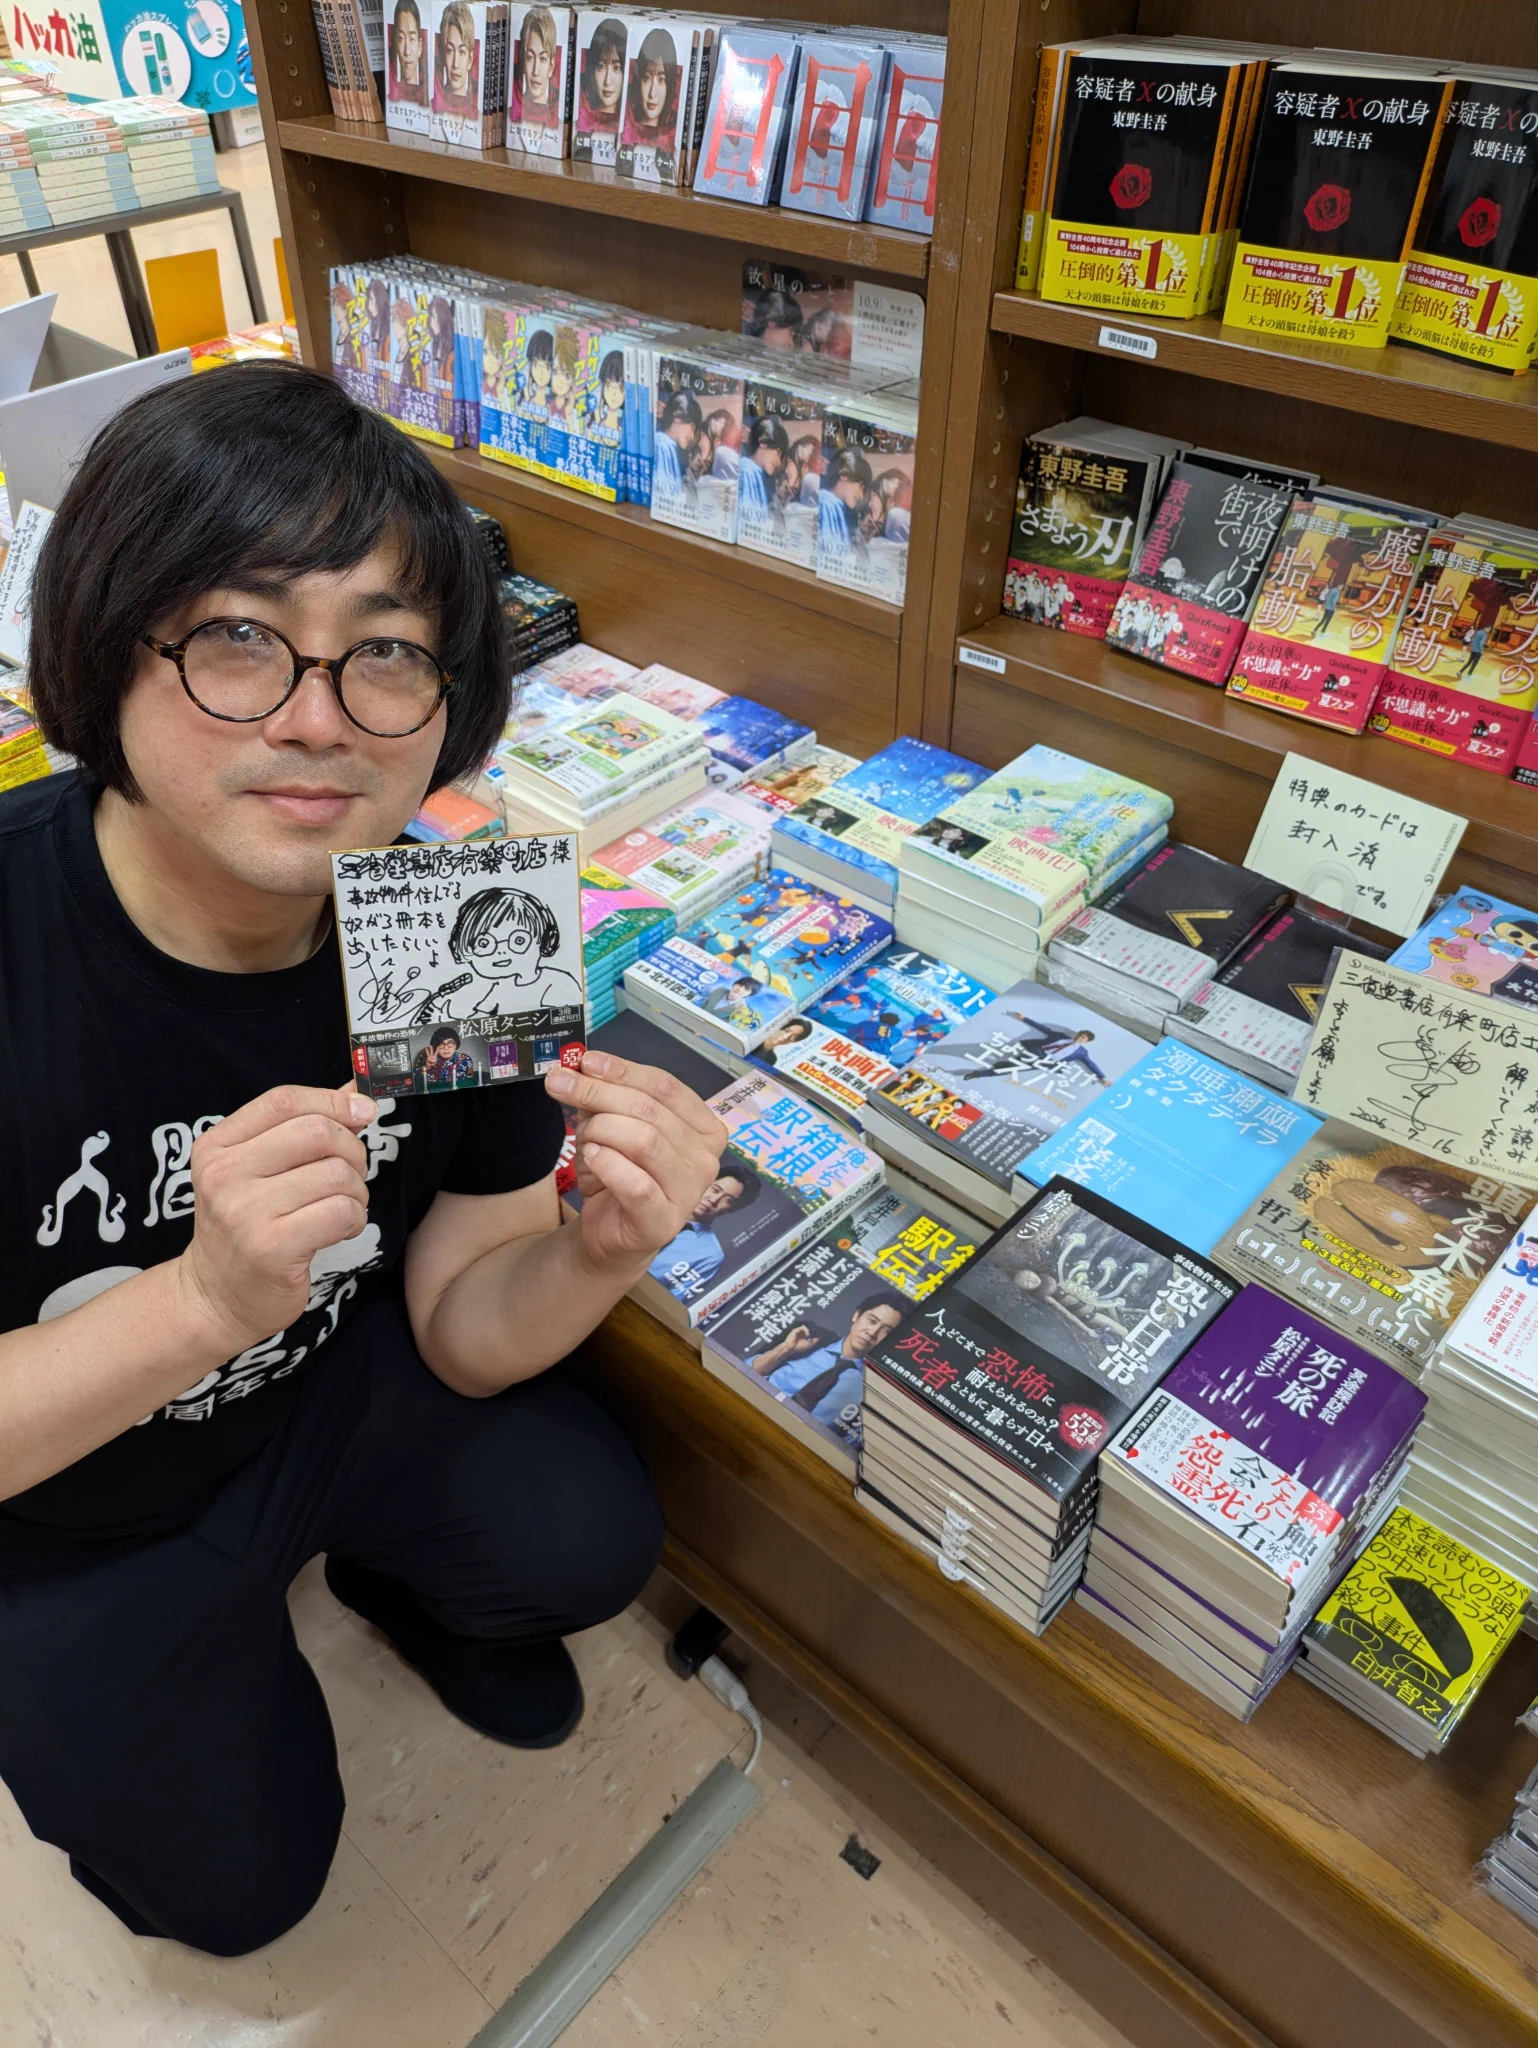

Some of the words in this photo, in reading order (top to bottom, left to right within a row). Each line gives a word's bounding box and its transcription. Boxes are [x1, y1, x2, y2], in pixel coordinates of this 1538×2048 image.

[13, 4, 103, 64] ハッカ油
[1074, 75, 1218, 109] 容疑者Xの献身
[1273, 89, 1431, 126] 容疑者Xの献身
[388, 105, 430, 122] に関するアンケート
[432, 116, 479, 136] に関するアンケート
[1111, 110, 1169, 132] 東野圭吾
[509, 125, 559, 144] に関するアンケート
[1310, 128, 1374, 151] 東野圭吾
[1470, 138, 1527, 165] 東野圭吾
[619, 149, 675, 171] に関するアンケート
[1059, 231, 1128, 248] 東野圭吾40周年記念企画
[1244, 255, 1317, 274] 東野圭吾40周年記念企画
[1253, 267, 1330, 287] 104冊から投票で選ばれた
[858, 295, 881, 310] 10.9
[1064, 287, 1167, 312] 天才の頭脳は母娘を救う
[1246, 313, 1356, 341] 天才の頭脳は母娘を救う
[1395, 321, 1495, 359] 天才の頭脳は母娘を救う
[1037, 453, 1129, 495] 東野圭吾
[1019, 503, 1134, 566] さまよう刃
[1138, 478, 1193, 577] 東野圭吾
[1213, 481, 1256, 549] 街で
[1292, 513, 1351, 540] 東野圭吾
[1217, 495, 1290, 615] 夜明けの
[1428, 547, 1498, 581] 東野圭吾
[1255, 545, 1317, 635] 胎動
[1349, 527, 1422, 650] 魔力の
[1185, 610, 1232, 636] QuizKnock
[1394, 580, 1460, 674] 胎動
[1240, 655, 1322, 680] 不思議な“力”
[1244, 640, 1302, 662] 少女・円華の
[1329, 658, 1369, 676] QuizKnock
[1317, 693, 1355, 711] 夏フェア
[1381, 697, 1471, 727] 不思議な“力”
[1382, 682, 1448, 705] 少女・円華の
[1477, 704, 1521, 723] QuizKnock
[1466, 739, 1506, 758] 夏フェア
[1288, 777, 1420, 839] 特典のカードは
[337, 837, 572, 882] 三省堂書店有楽町店様
[1007, 836, 1077, 875] 映画化!
[1287, 819, 1380, 871] 封入済
[1430, 852, 1446, 875] BOOKS
[1440, 822, 1459, 853] SANSEIDO
[346, 881, 461, 909] 事故物件住んでる
[1354, 885, 1388, 910] です。
[340, 911, 447, 933] 奴が3冊本を
[346, 933, 439, 956] 出したらしい
[429, 949, 440, 968] よ
[634, 963, 651, 975] 主演
[650, 966, 697, 1001] 北村匠海
[887, 950, 986, 1010] 4アウト
[1363, 963, 1387, 979] BOOKS
[1387, 972, 1422, 990] SANSEIDO
[457, 1012, 549, 1039] 松原タニシ
[552, 1013, 579, 1024] 連続刊行
[557, 1008, 572, 1016] 3冊
[359, 1027, 417, 1044] 事故物件の恐怖
[524, 1031, 569, 1043] 心霊スポットの恐怖
[1306, 998, 1350, 1106] よろしくお願いします。
[964, 1042, 1078, 1102] エスパー
[989, 1030, 1100, 1088] ちょっとだけ
[711, 1075, 768, 1116] 池井戸潤
[1141, 1066, 1279, 1147] ダクダデイラ
[728, 1096, 815, 1157] 駅伝
[764, 1121, 850, 1185] 箱根
[798, 1146, 871, 1200] 俺たちの
[1481, 1160, 1505, 1173] BOOKS
[1289, 1158, 1335, 1205] 笑い飯
[799, 1170, 883, 1243] 俺たちの箱根駅伝
[850, 1194, 902, 1238] 池井戸潤
[1016, 1189, 1074, 1240] 松原タニシ
[1256, 1198, 1319, 1239] 哲夫
[1254, 1222, 1280, 1239] amazon
[869, 1215, 957, 1289] 駅伝
[1247, 1238, 1288, 1267] 第1位
[1395, 1176, 1533, 1337] 頭を木魚に
[695, 1268, 759, 1322] ドラマ化決定
[742, 1245, 834, 1322] 主演・大泉洋
[1172, 1252, 1235, 1300] 事故物件生活
[1312, 1276, 1353, 1307] 第1位
[743, 1256, 856, 1353] ドラマ化決定!
[1482, 1284, 1512, 1326] 待望の書籍化
[1487, 1290, 1528, 1350] 著者初の新聞連載、
[1097, 1272, 1210, 1386] 恐い日常
[1378, 1317, 1421, 1350] 第1位
[924, 1308, 1057, 1408] 人はどこまで恐怖に
[1253, 1325, 1302, 1379] 松原タニシ
[965, 1366, 1060, 1434] 耐えられるのか?
[1272, 1343, 1348, 1420] 死の旅
[1317, 1366, 1369, 1427] 冥途探訪記
[1138, 1402, 1181, 1453] 神話の地を巡る旅
[1157, 1414, 1200, 1465] 死の恐怖が生んだ
[1164, 1433, 1225, 1505] 怨霊
[1361, 1556, 1392, 1584] って
[1378, 1523, 1520, 1624] 超速い人の頭
[1391, 1508, 1530, 1602] 本を読むのが
[1345, 1571, 1393, 1606] んの
[1368, 1541, 1506, 1638] の中ってどうな
[1333, 1583, 1428, 1653] 殺人事件
[1350, 1649, 1443, 1724] 白井智之
